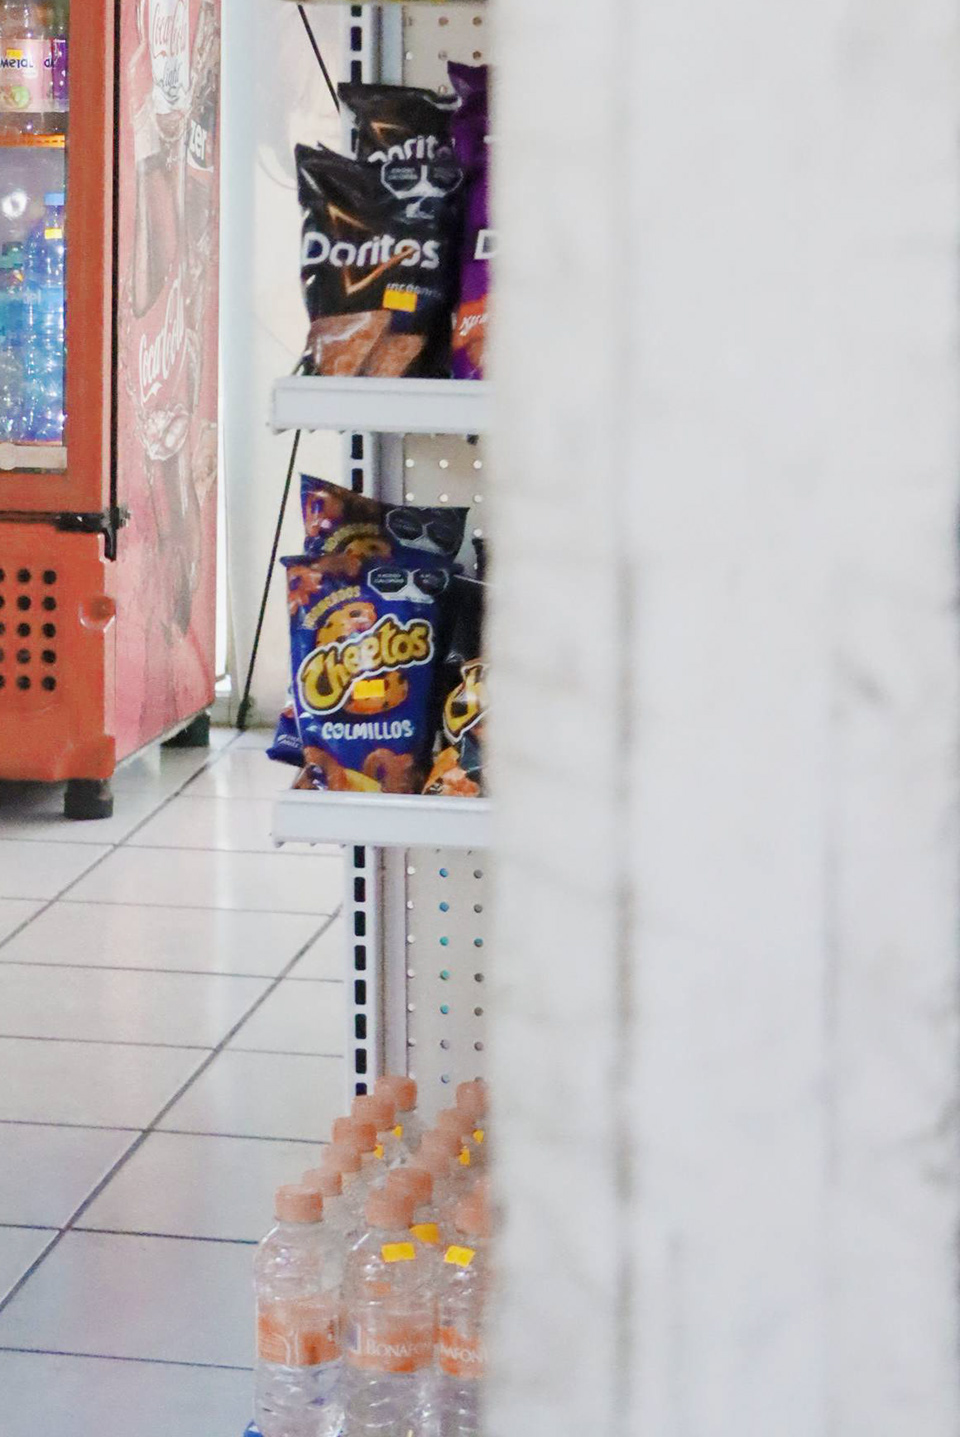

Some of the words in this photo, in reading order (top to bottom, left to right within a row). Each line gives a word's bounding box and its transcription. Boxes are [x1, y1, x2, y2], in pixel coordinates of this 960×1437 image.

[302, 231, 440, 270] Doritos
[299, 618, 432, 712] Cheetos
[321, 720, 414, 741] COLMILLOS
